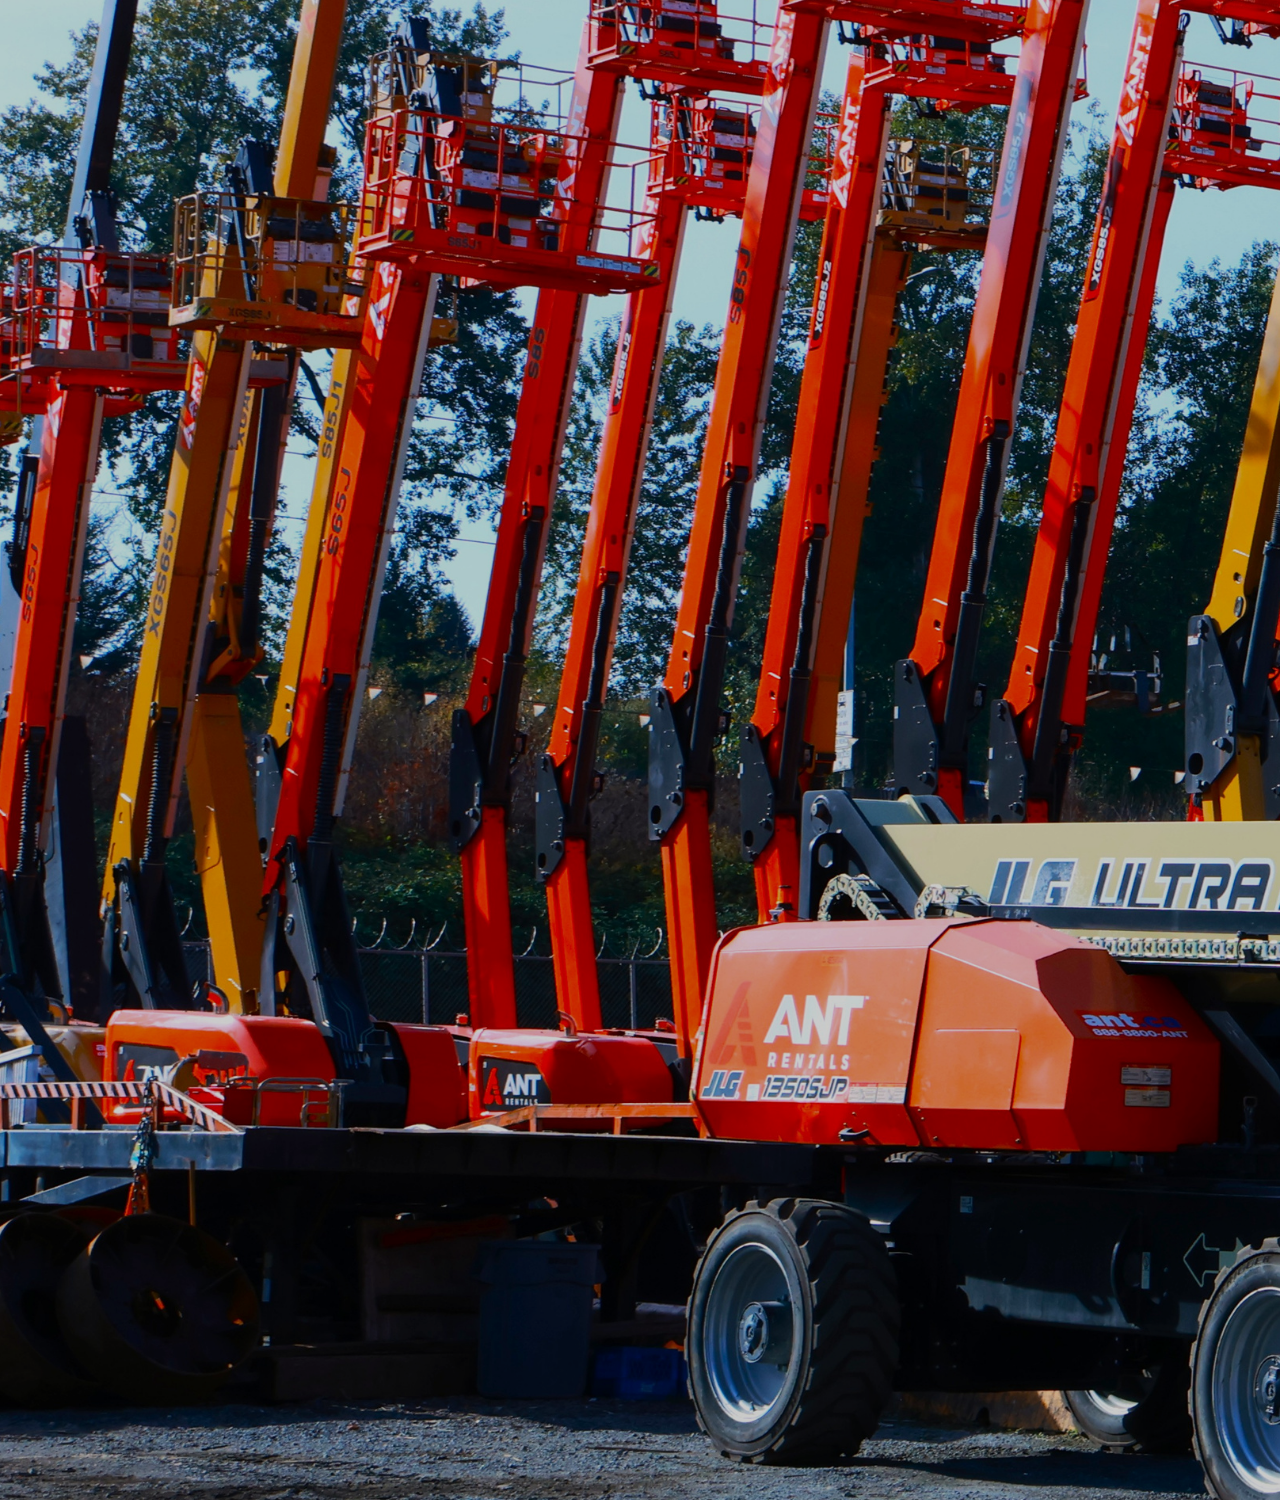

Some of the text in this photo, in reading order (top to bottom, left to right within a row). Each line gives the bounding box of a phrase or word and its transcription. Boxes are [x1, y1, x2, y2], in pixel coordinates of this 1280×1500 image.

[1125, 26, 1147, 102] ANT
[839, 96, 857, 169] ANT
[1001, 111, 1027, 198] XGS85J2
[1090, 205, 1113, 284] XGS85J2
[729, 248, 751, 325] S85J
[814, 259, 832, 334] XGS85J2
[528, 326, 547, 380] S85
[613, 332, 633, 400] XGS85J2
[321, 380, 343, 460] S85J1
[327, 467, 351, 556] S65J
[22, 541, 40, 624] S65J
[149, 509, 178, 638] XGS65J
[1092, 858, 1275, 911] ULTRA
[763, 994, 867, 1046] ANT
[1082, 1013, 1182, 1028] ant.ca
[1092, 1029, 1188, 1039] 888-8800-ANT
[503, 1073, 542, 1096] ANT
[701, 1070, 743, 1099] JLG
[763, 1076, 849, 1099] 1350SJP
[767, 1052, 850, 1071] RENTALS
[505, 1098, 539, 1106] RENTALS
